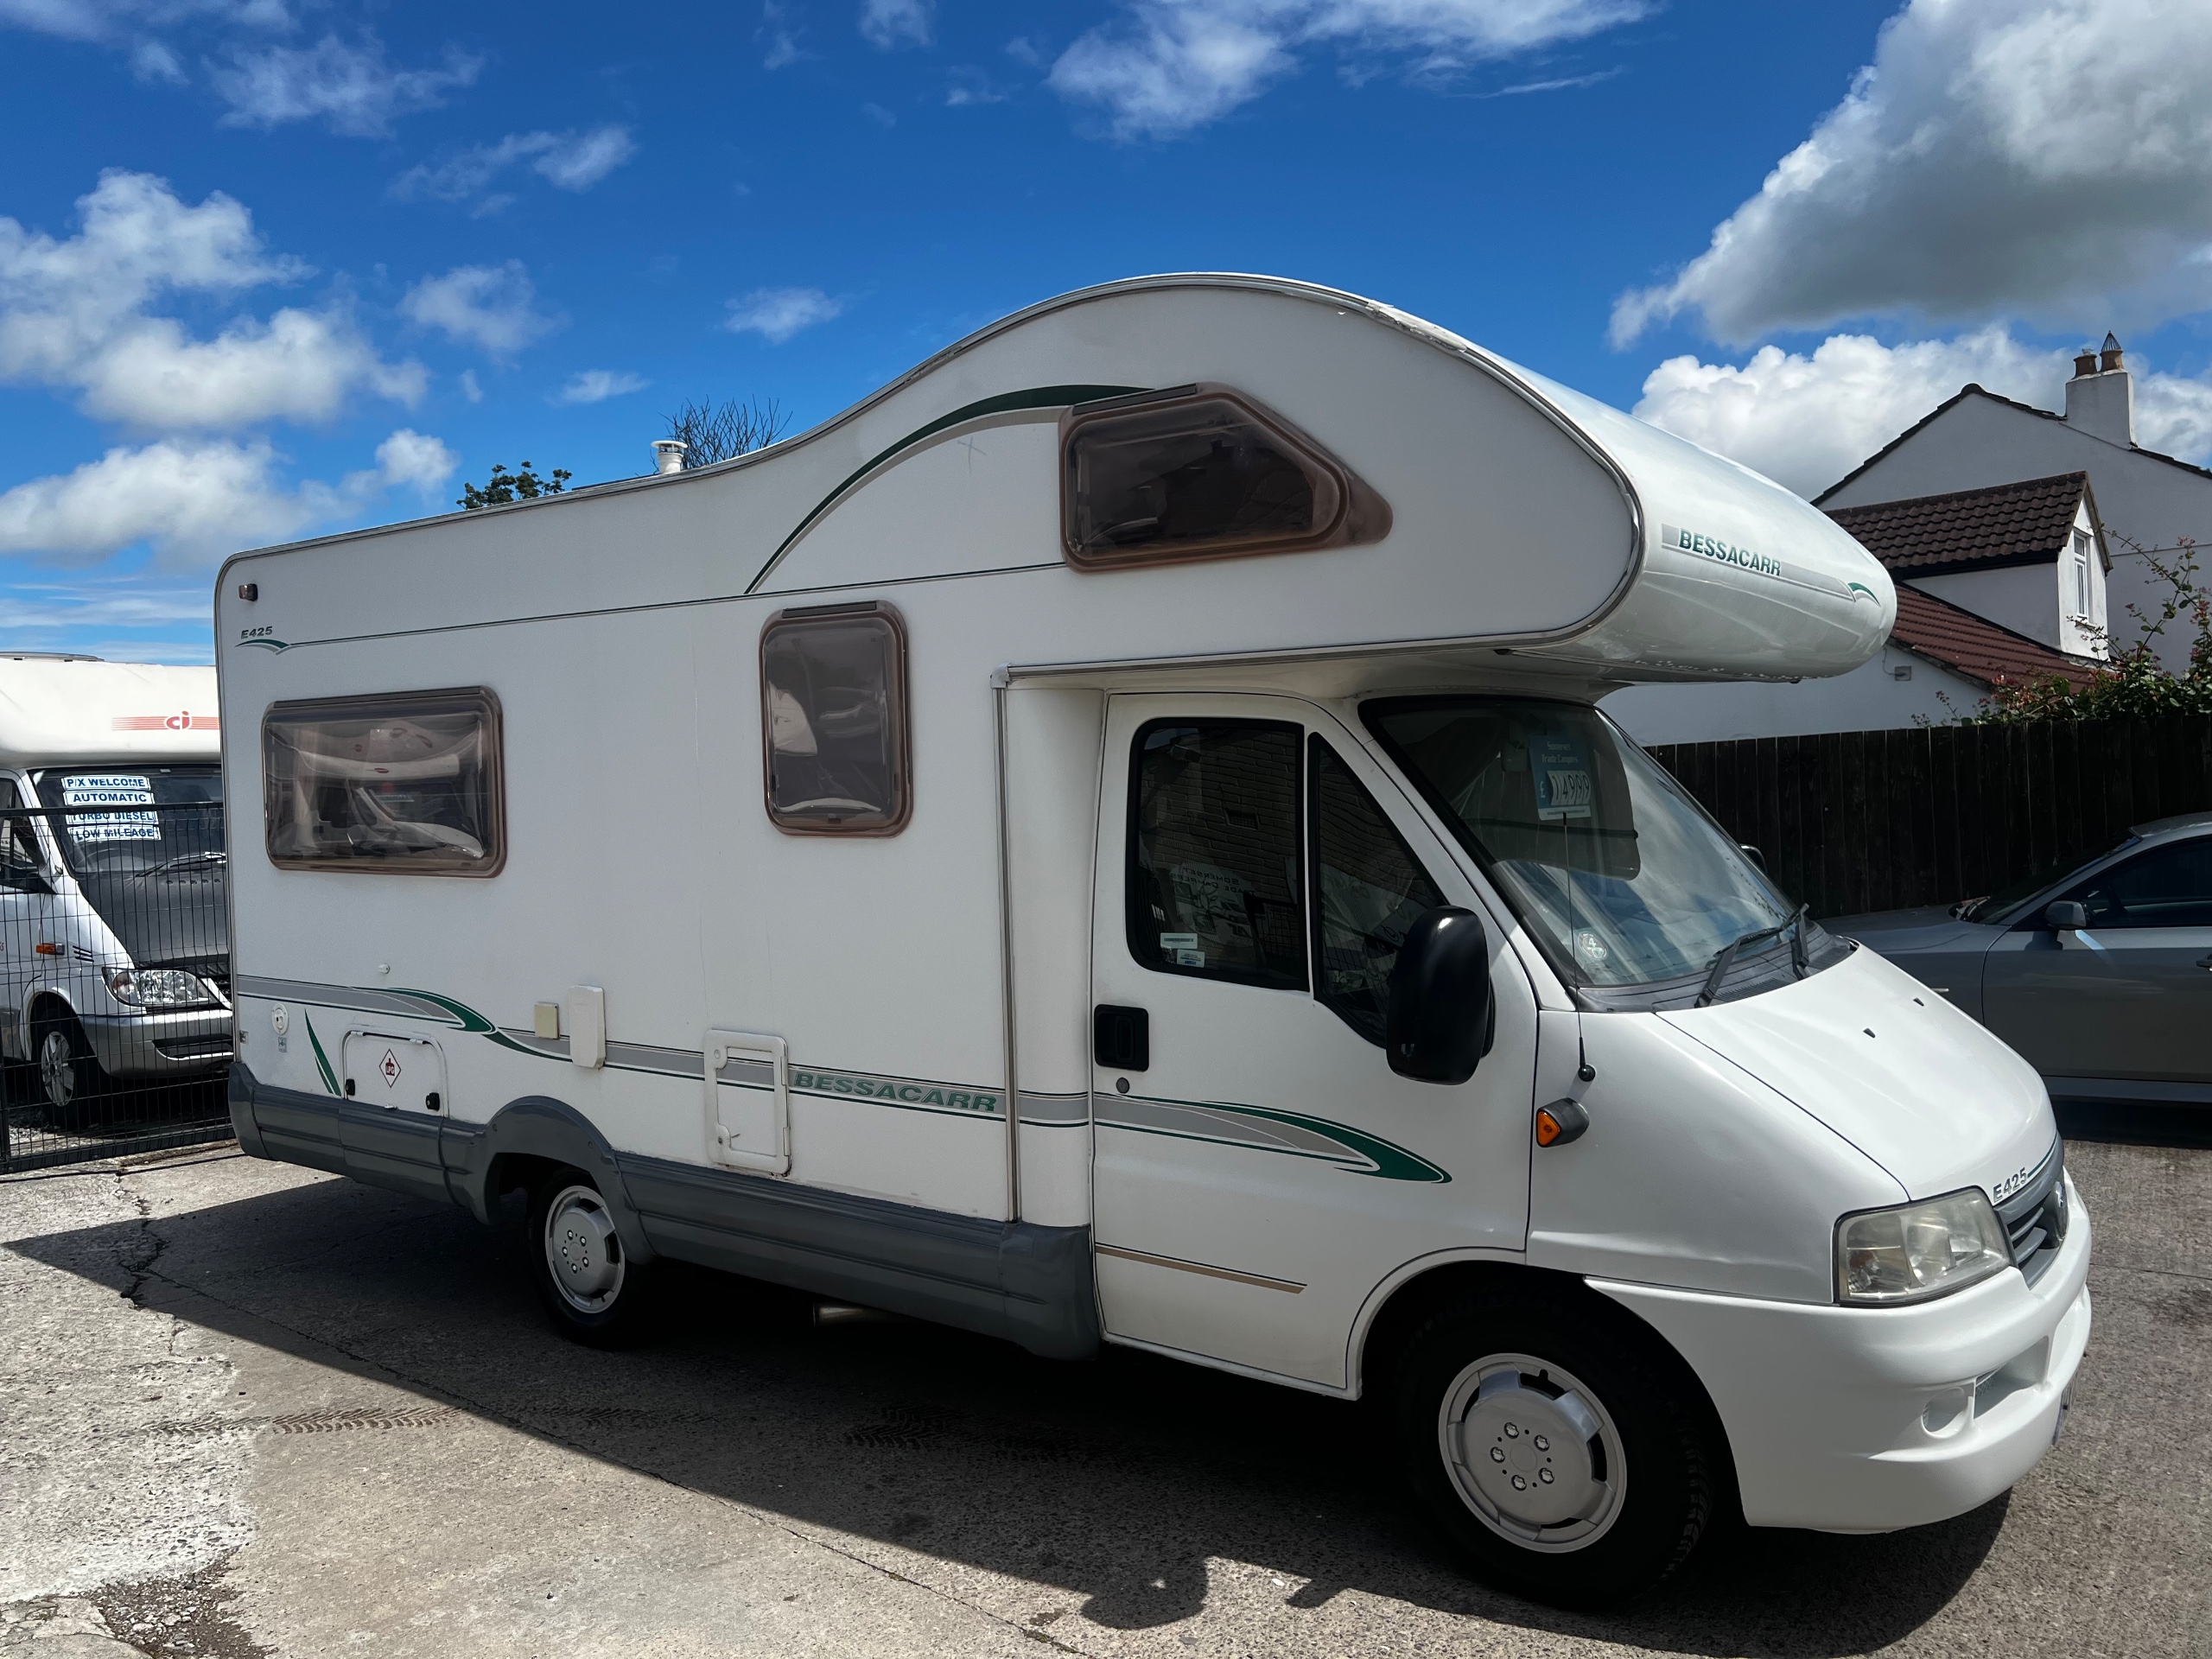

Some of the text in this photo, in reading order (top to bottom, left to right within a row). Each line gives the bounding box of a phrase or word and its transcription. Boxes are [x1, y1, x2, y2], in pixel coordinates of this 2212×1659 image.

[1678, 528, 1782, 577] BESSACARR
[240, 626, 273, 639] E425
[67, 778, 146, 787] P/X WELCOME
[73, 793, 147, 803] AUTOMATIC
[114, 810, 154, 821] DIESEL
[75, 828, 155, 841] LOW MILEAGE
[385, 1065, 395, 1074] LPG
[793, 1071, 998, 1112] BESSACARR
[1993, 1166, 2028, 1204] E425
